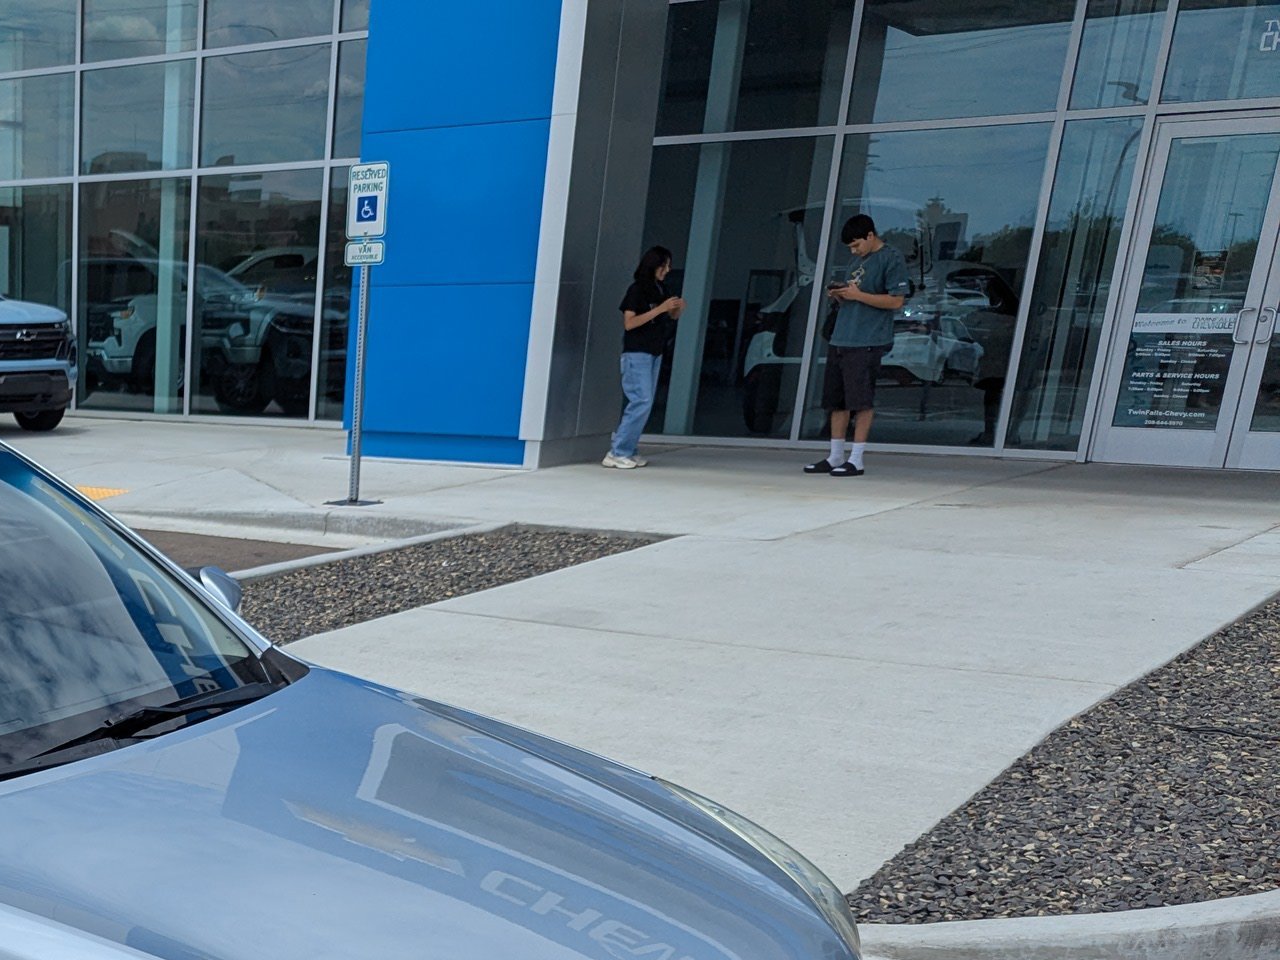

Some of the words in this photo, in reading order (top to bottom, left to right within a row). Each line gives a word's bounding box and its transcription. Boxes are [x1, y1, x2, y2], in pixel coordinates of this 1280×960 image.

[352, 168, 386, 181] RESERVED
[353, 182, 383, 193] PARKING
[358, 246, 372, 254] VAN
[1128, 409, 1205, 418] TwinFalls-Chevy.com
